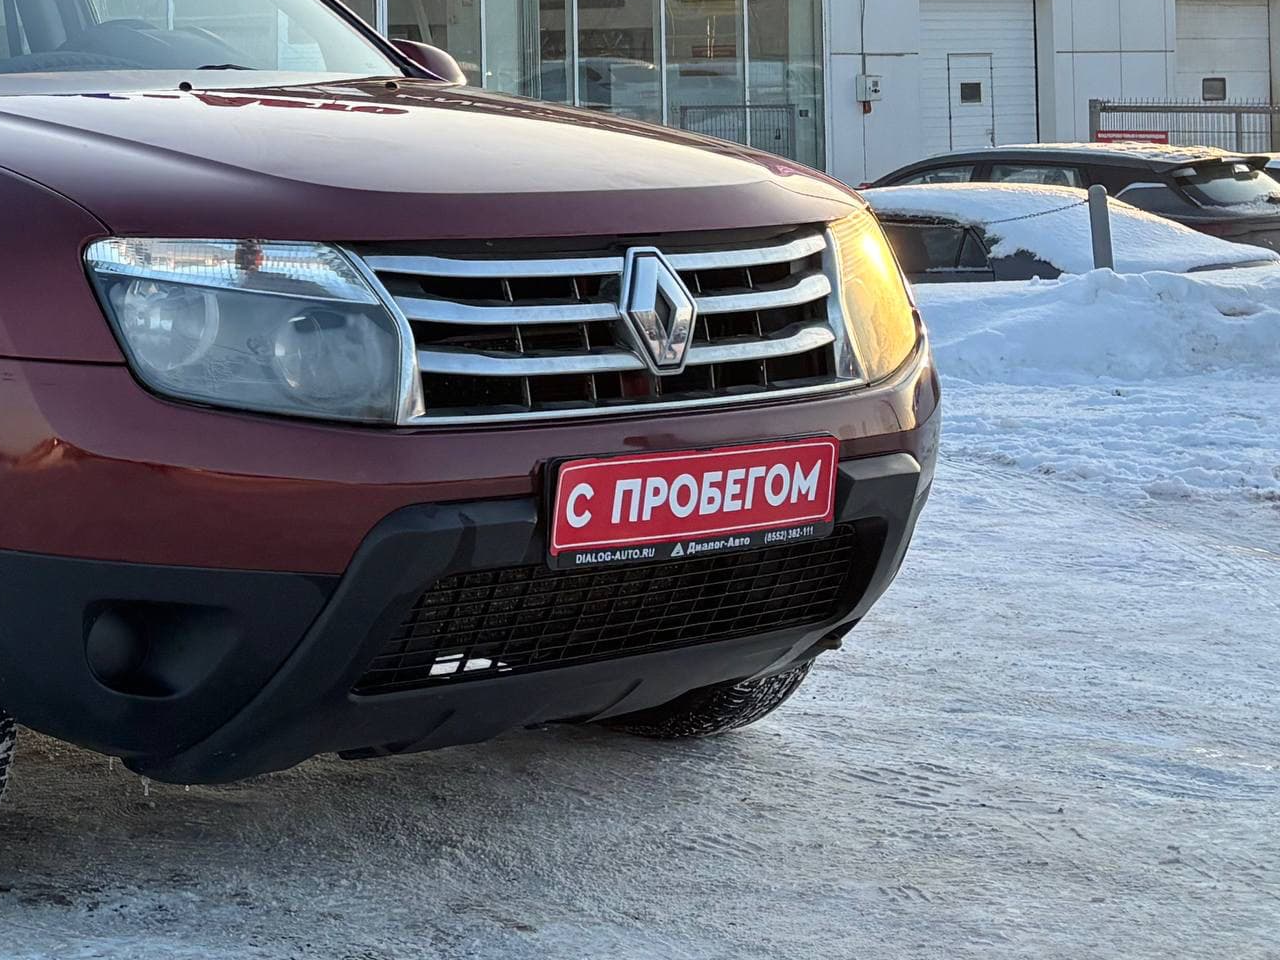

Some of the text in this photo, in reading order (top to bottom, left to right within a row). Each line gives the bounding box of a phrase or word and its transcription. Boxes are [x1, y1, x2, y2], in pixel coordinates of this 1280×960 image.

[566, 459, 822, 528] С ПРОБЕГОМ
[575, 547, 656, 565] DIALOG-AUTO.RU
[686, 536, 751, 557] Диалог-Авто
